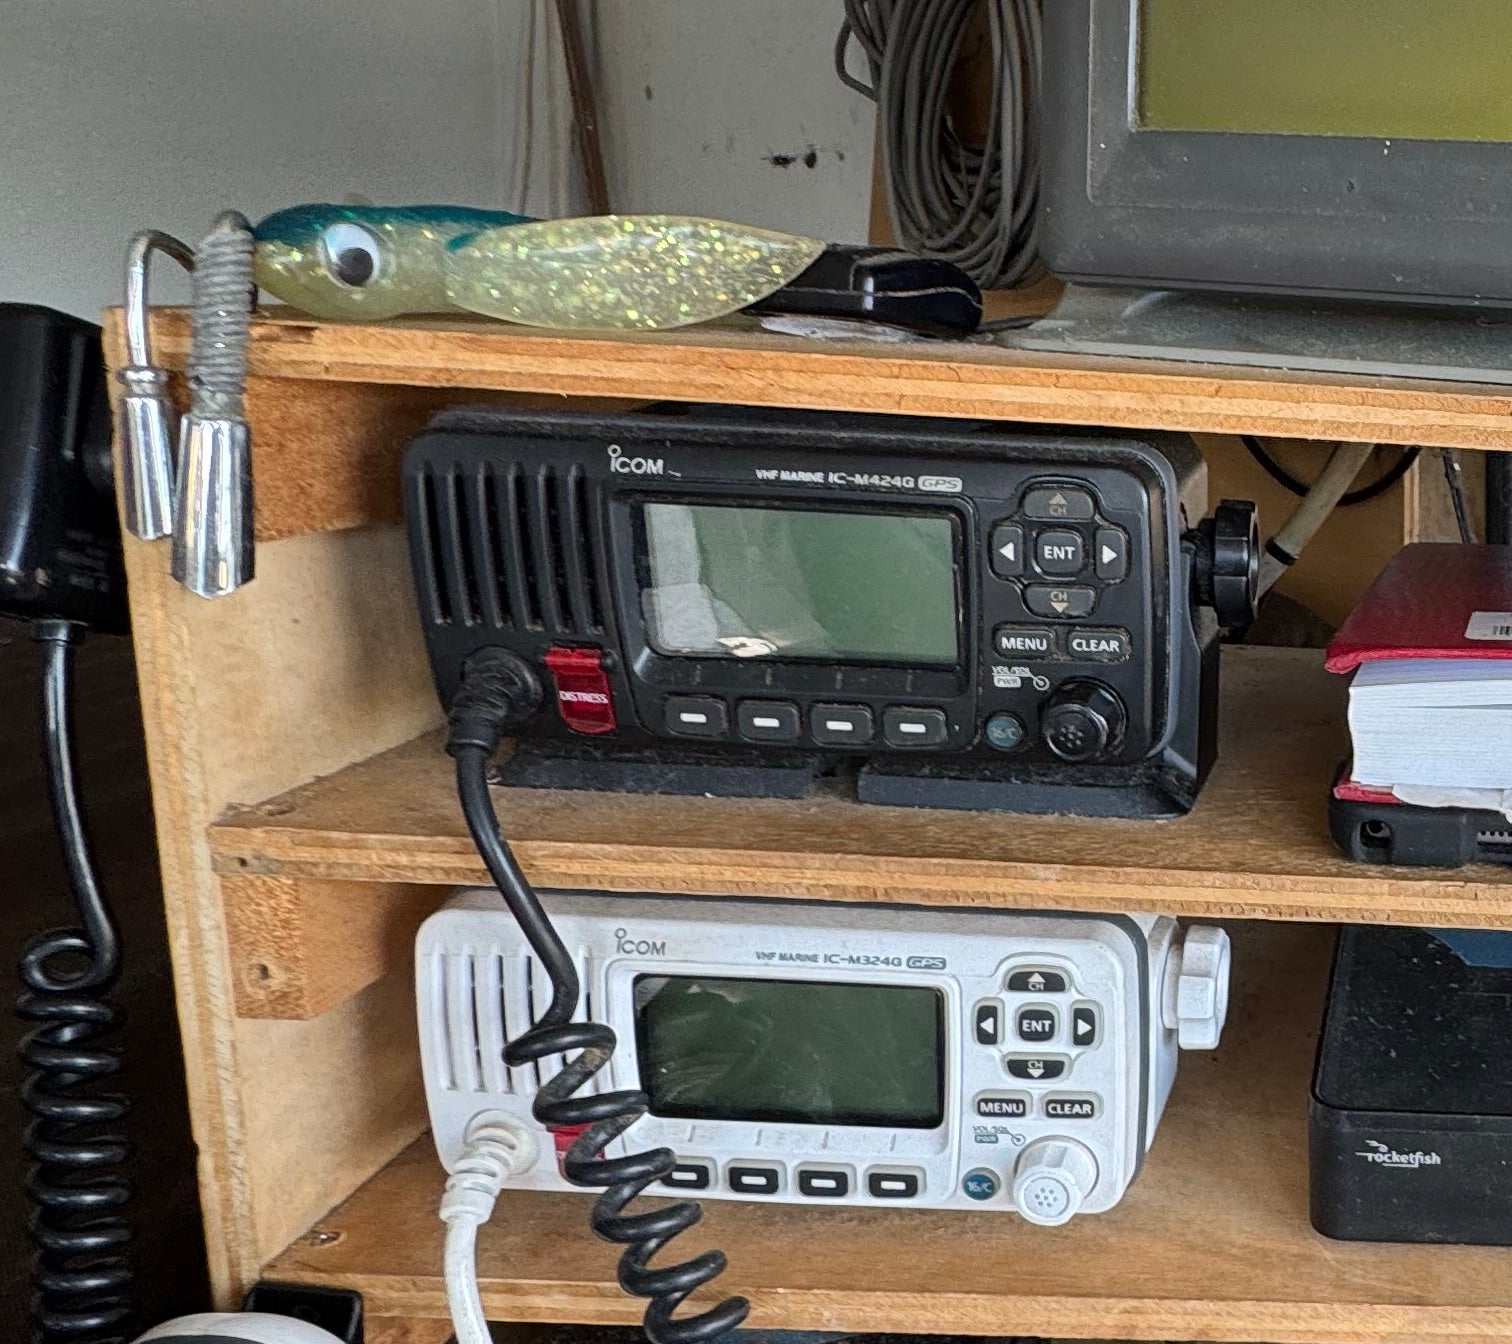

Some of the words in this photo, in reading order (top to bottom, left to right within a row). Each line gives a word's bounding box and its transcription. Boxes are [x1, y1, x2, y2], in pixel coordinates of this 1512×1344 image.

[780, 470, 825, 483] MARINE
[828, 472, 915, 488] IC-M424G
[922, 477, 959, 490] GPS
[1044, 545, 1075, 560] ENT
[1050, 591, 1068, 603] CH
[1001, 636, 1047, 651] MENU
[1072, 638, 1119, 653] CLEAR
[559, 690, 609, 704] DISTRESS
[908, 957, 945, 969] GPS
[1028, 982, 1045, 992] CH
[1022, 1019, 1051, 1033] ENT
[1027, 1060, 1045, 1070] CH
[979, 1102, 1024, 1114] MENU
[1048, 1102, 1092, 1115] CLEAR
[1356, 1150, 1441, 1169] rocketfish
